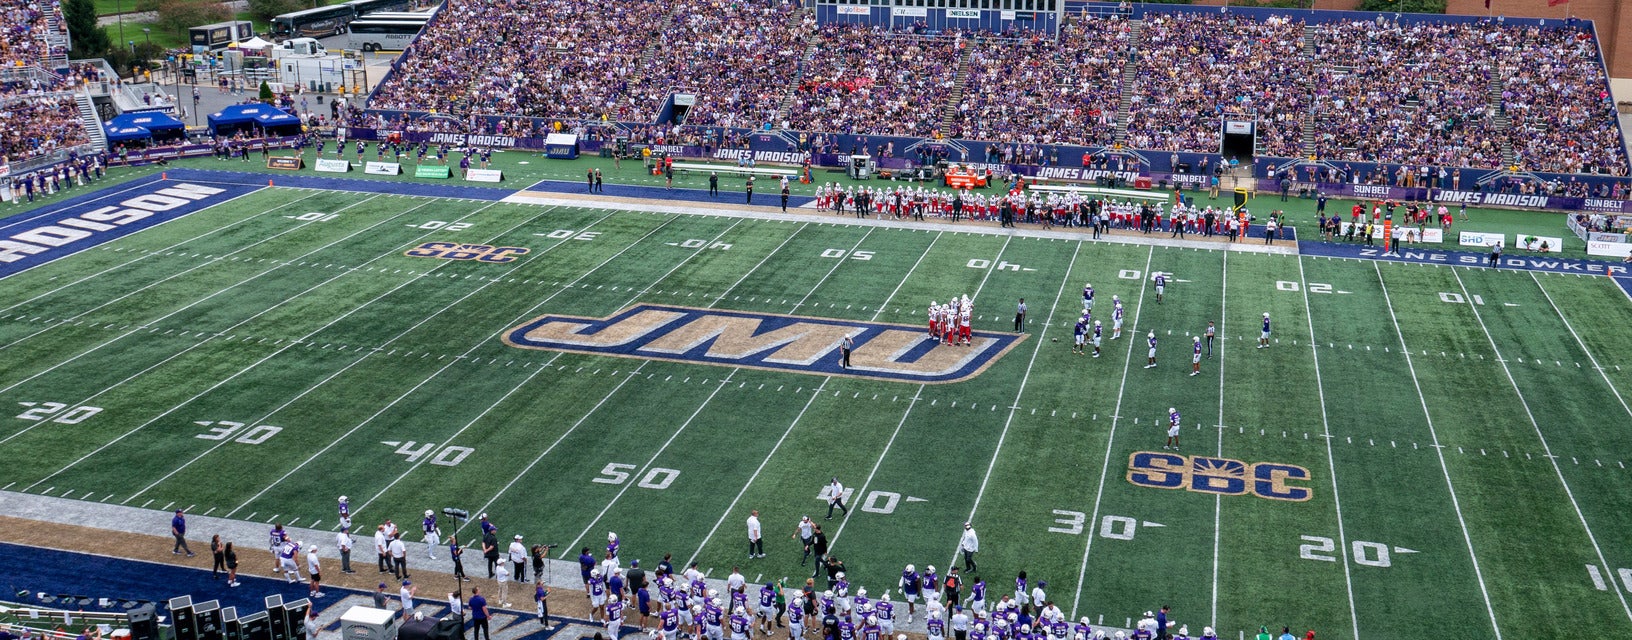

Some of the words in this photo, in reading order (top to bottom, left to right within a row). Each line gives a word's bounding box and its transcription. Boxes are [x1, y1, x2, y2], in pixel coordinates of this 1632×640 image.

[430, 133, 466, 144] JAMES
[467, 134, 516, 147] MADISON
[653, 144, 668, 152] SUN
[713, 148, 752, 160] JAMES
[754, 151, 806, 164] MADISON
[1037, 167, 1080, 179] JAMES
[1081, 169, 1140, 183] MADSON
[1172, 173, 1188, 182] SUN
[1189, 175, 1207, 184] BELT
[1353, 184, 1371, 194] SUN
[1371, 186, 1392, 195] BELT
[1434, 190, 1483, 204] JAMES
[1484, 193, 1549, 207] MADISON
[1584, 199, 1600, 208] SUN
[1600, 200, 1624, 209] BELT
[1461, 234, 1483, 244] SHD
[404, 241, 531, 263] SBC
[1359, 248, 1448, 261] ZANE
[1459, 255, 1629, 275] SHOWKER
[506, 306, 1018, 381] JMU
[16, 401, 104, 425] 20
[195, 420, 283, 445] 30
[395, 440, 475, 467] 40
[592, 462, 682, 490] 50
[1127, 450, 1314, 501] SBC
[816, 485, 901, 514] 40
[1048, 509, 1137, 541] 30
[1300, 535, 1392, 567] 20
